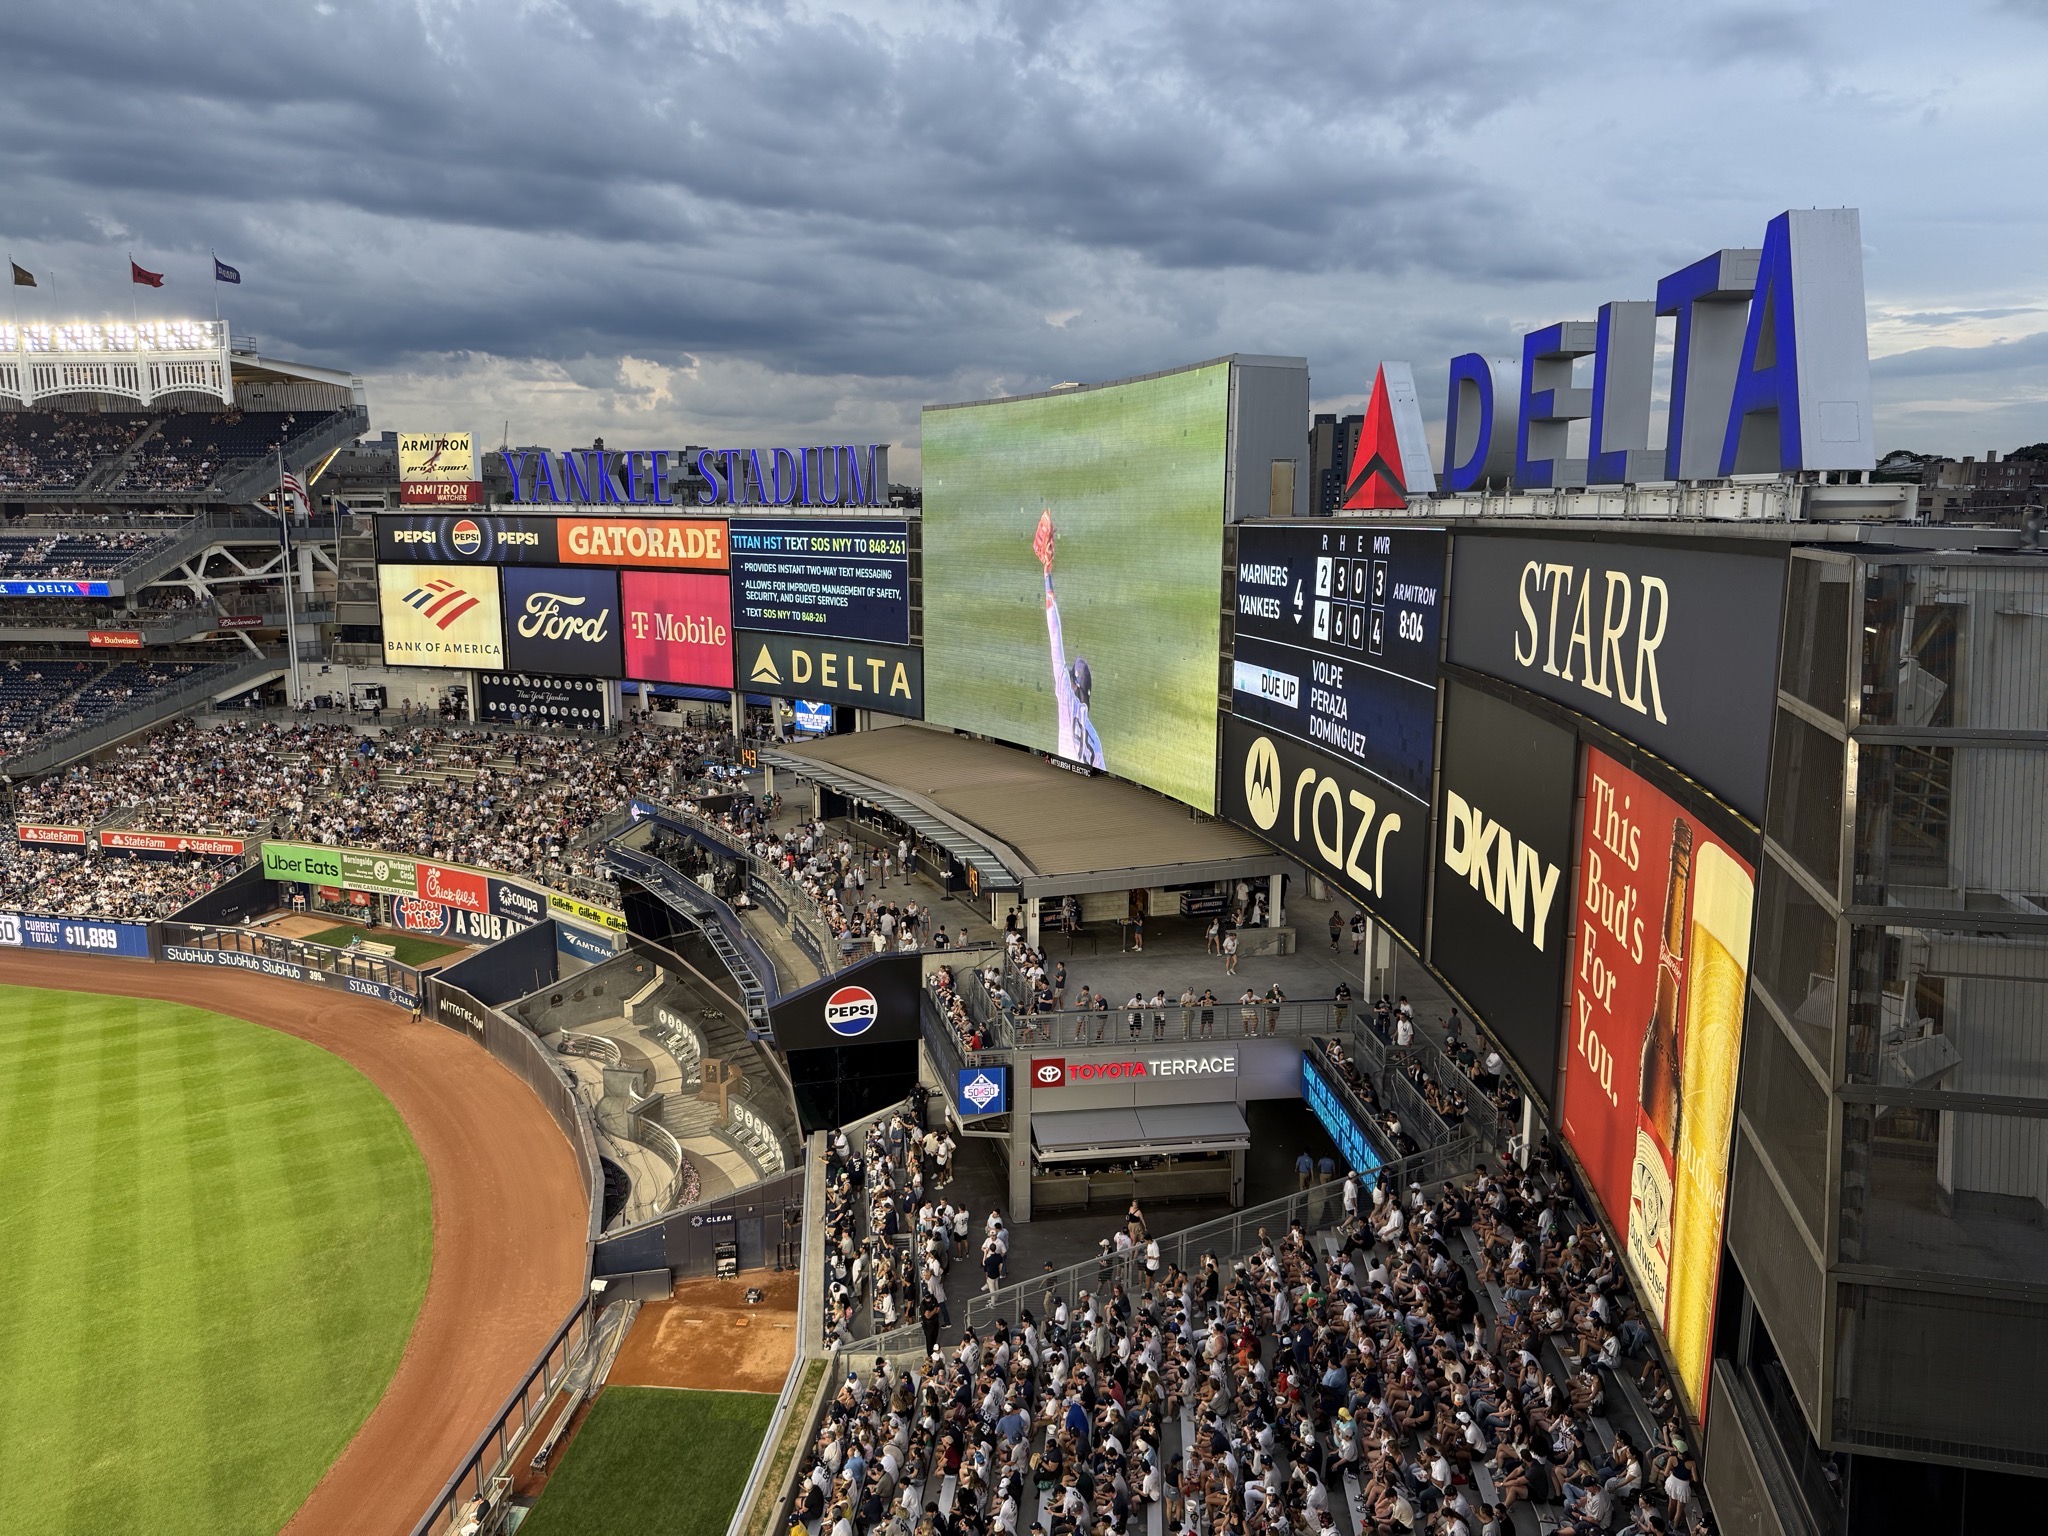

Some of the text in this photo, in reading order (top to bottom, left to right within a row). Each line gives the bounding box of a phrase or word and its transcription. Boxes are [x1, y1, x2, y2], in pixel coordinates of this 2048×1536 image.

[1443, 209, 1802, 493] DELTA
[401, 439, 469, 452] ARMITRON
[502, 444, 881, 506] YANKEE STADIUM
[407, 484, 468, 495] ARMITRON
[394, 530, 437, 544] PEPSI
[454, 530, 480, 542] PEPSI
[497, 531, 539, 546] PEPSI
[568, 526, 723, 559] GATORADE
[732, 535, 906, 555] TITAN HST TEXT SOS NYY TO 848-261
[1322, 535, 1328, 551] R
[1339, 535, 1346, 552] H
[1357, 535, 1363, 553] E
[1373, 536, 1391, 555] MVR
[744, 563, 892, 580] PROVIDES INSTANT TWO-WAY TEXT MESSAGING
[1240, 563, 1288, 587] MARINERS
[1320, 564, 1328, 589] 2
[1338, 566, 1345, 592] 3
[1355, 569, 1362, 594] 0
[1376, 570, 1384, 597] 3
[37, 584, 75, 593] DELTA
[745, 580, 902, 601] ALLOWS FOR IMPROVED MANAGEMENT OF SAFETY,
[746, 591, 849, 607] SECURITY, AND GUEST SERVICES
[1293, 579, 1304, 610] 4
[1393, 582, 1435, 606] ARMITRON
[517, 592, 609, 643] Ford
[745, 607, 827, 623] TEXT SOS NYY TO 848-261
[1239, 595, 1280, 620] YANKEES
[654, 613, 727, 646] Mobile
[1318, 608, 1325, 632] 4
[1336, 611, 1342, 635] 6
[1353, 614, 1360, 639] 0
[1373, 618, 1380, 645] 4
[1399, 610, 1423, 643] 8:06
[104, 636, 139, 645] Budweiser
[387, 641, 501, 655] BANK OF AMERICA
[1515, 560, 1668, 725] STARR
[792, 650, 912, 699] DELTA
[1312, 659, 1343, 689] VOLPE
[1261, 673, 1296, 701] DUE UP
[1311, 688, 1348, 720] PERAZA
[1310, 714, 1366, 759] DOMÍNGUEZ
[1050, 757, 1091, 778] MITSUBISHI ELECTRIC
[1293, 767, 1401, 899] razr
[1592, 773, 1641, 872] This
[266, 854, 339, 877] Uber Eats
[400, 870, 415, 881] Circle
[1444, 789, 1561, 952] DKNY
[347, 882, 414, 897] WWW.CASSENACARE.COM
[426, 873, 479, 907] Chick-fil-A
[401, 897, 441, 915] Jersey
[512, 892, 539, 914] coupa
[551, 897, 601, 923] Gillette Gillette
[1585, 848, 1645, 965] Bud's
[24, 920, 61, 934] CURRENT
[455, 909, 467, 935] A
[30, 931, 58, 944] TOTAL:
[65, 926, 118, 949] $11,889
[576, 939, 612, 958] AMTRAK
[167, 948, 301, 979] StubHub StubHub StubHub
[1579, 920, 1617, 1015] For
[349, 979, 381, 998] STARR
[828, 1004, 874, 1018] PEPSI
[1577, 988, 1618, 1108] You.
[1067, 1057, 1235, 1080] TOYOTA TERRACE
[983, 1086, 995, 1096] 50
[1326, 1091, 1350, 1138] SELLERS
[1350, 1125, 1364, 1157] AND
[1341, 1131, 1352, 1162] THE
[706, 1215, 732, 1223] CLEAR
[1629, 1212, 1665, 1304] Budweiser
